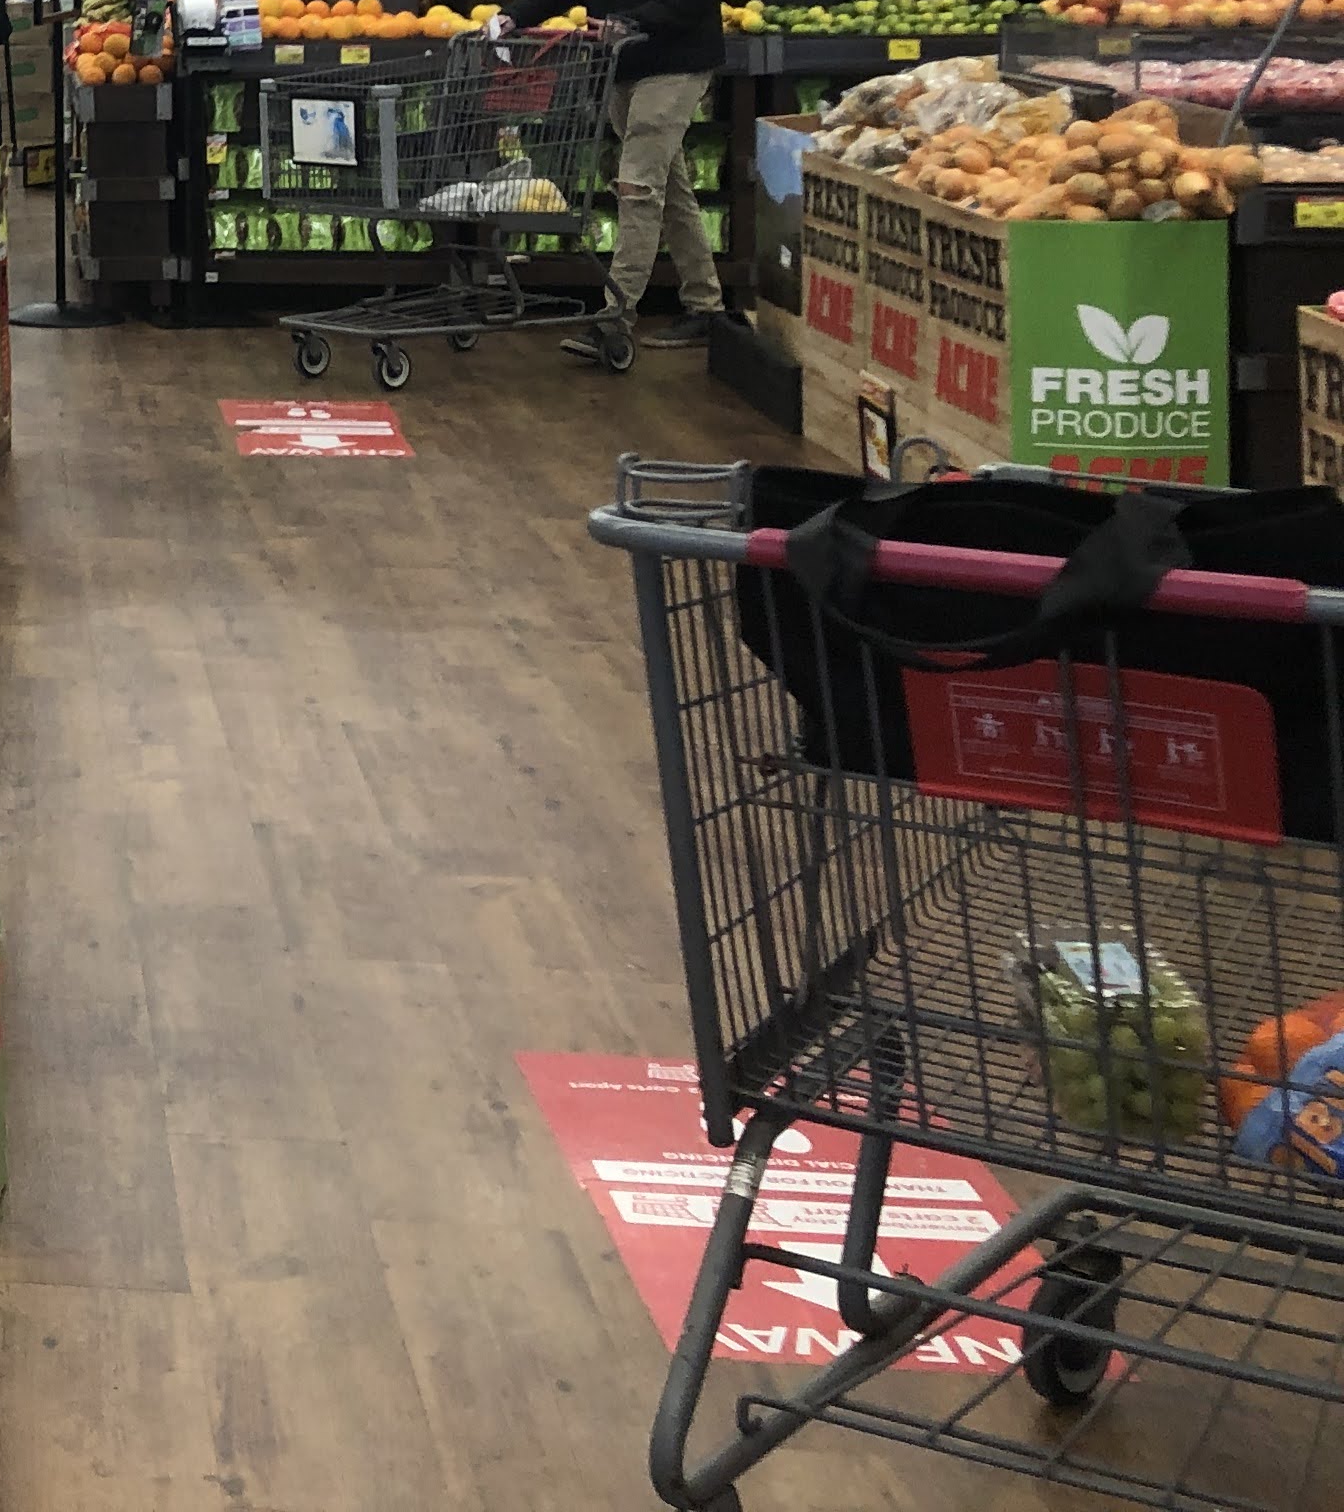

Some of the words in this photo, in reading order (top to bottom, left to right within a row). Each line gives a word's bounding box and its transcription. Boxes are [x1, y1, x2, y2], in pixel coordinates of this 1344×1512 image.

[1031, 367, 1211, 406] FRESH
[1031, 409, 1212, 439] PRODUCE
[886, 1184, 946, 1193] THAN
[879, 1222, 990, 1234] Remembe
[914, 1334, 1024, 1366] NE
